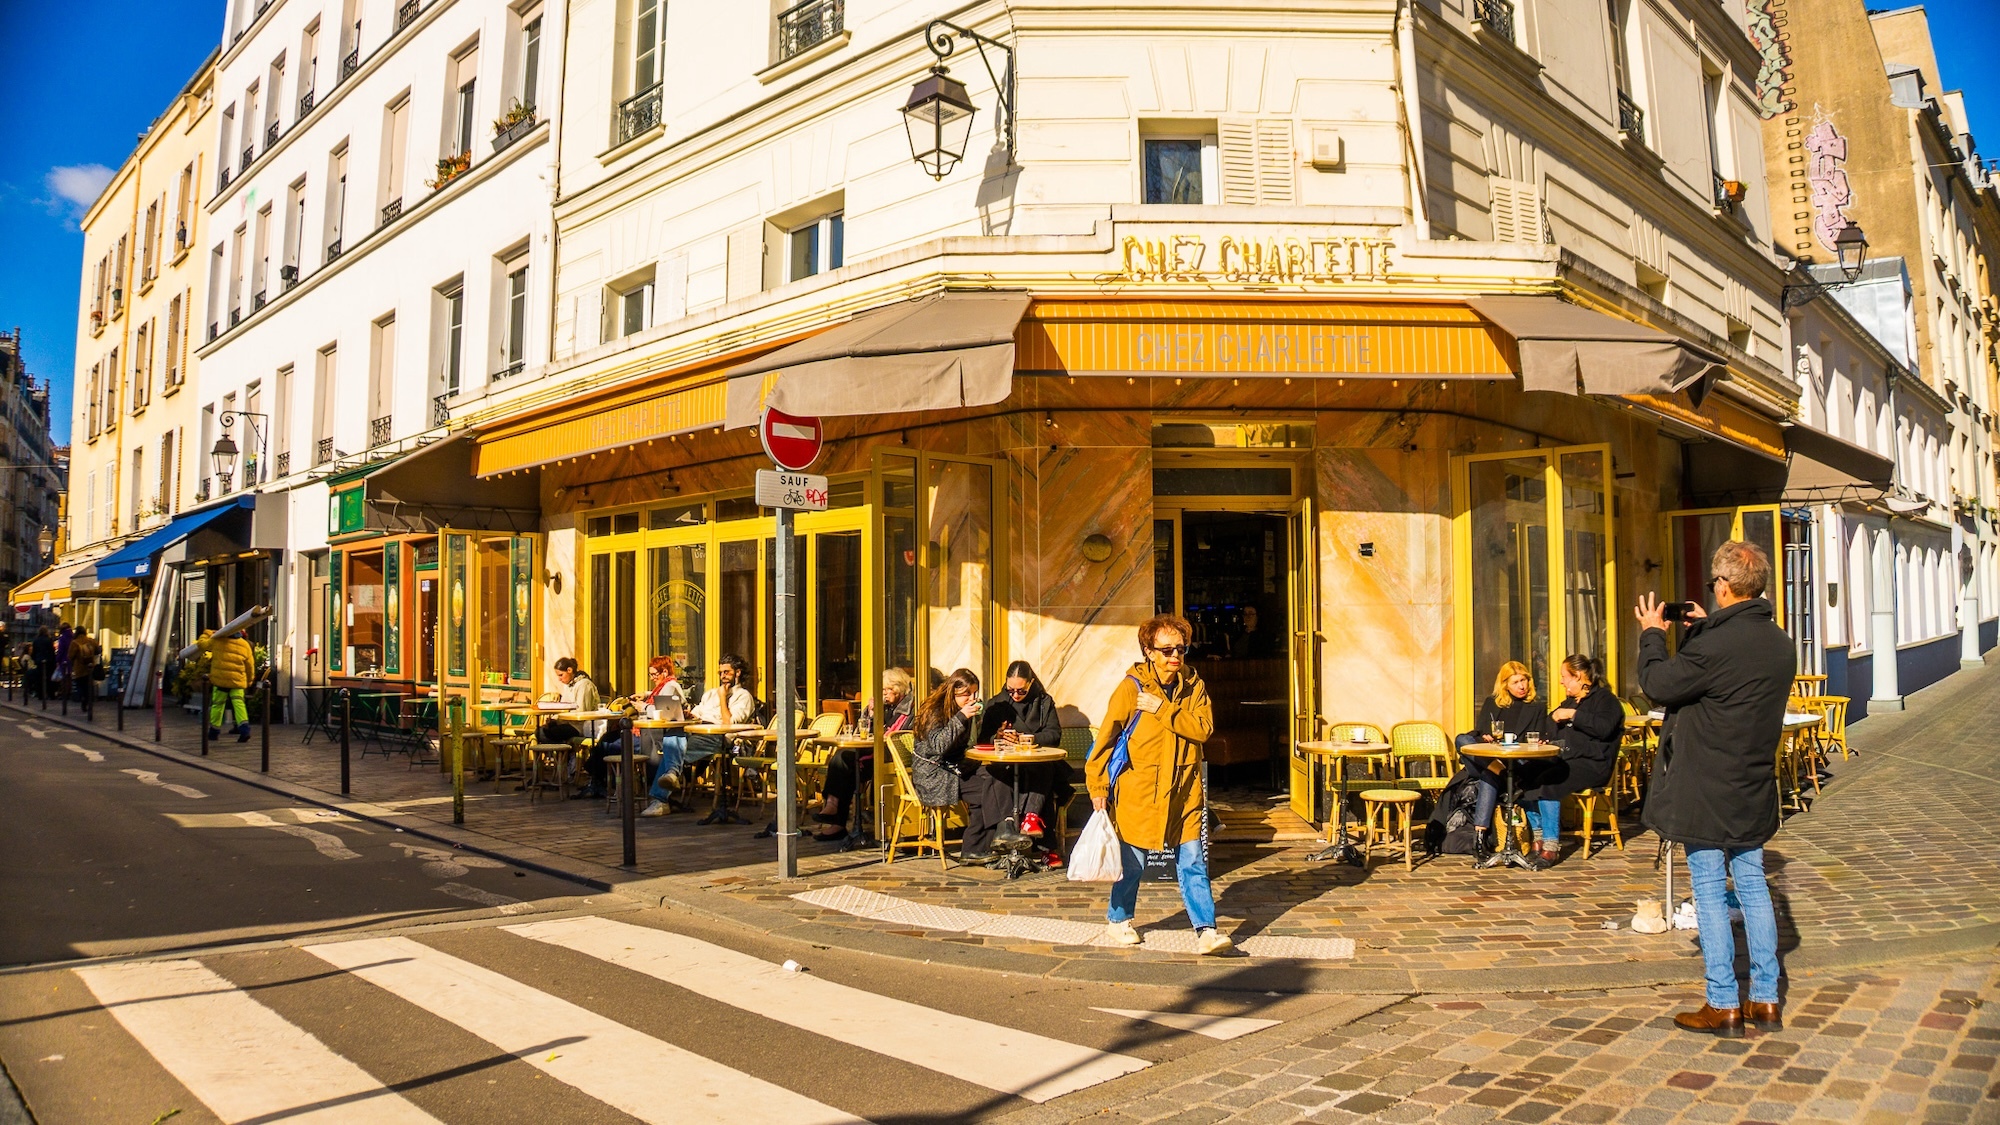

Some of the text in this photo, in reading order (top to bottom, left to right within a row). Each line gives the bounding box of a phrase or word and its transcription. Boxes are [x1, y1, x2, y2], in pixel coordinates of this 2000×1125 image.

[1123, 235, 1394, 276] CHEZ CHARLETTE
[1137, 333, 1372, 365] CHEZ CHARLETTE
[592, 399, 680, 442] CHEZ CHARLETTE
[780, 475, 809, 487] SAUF
